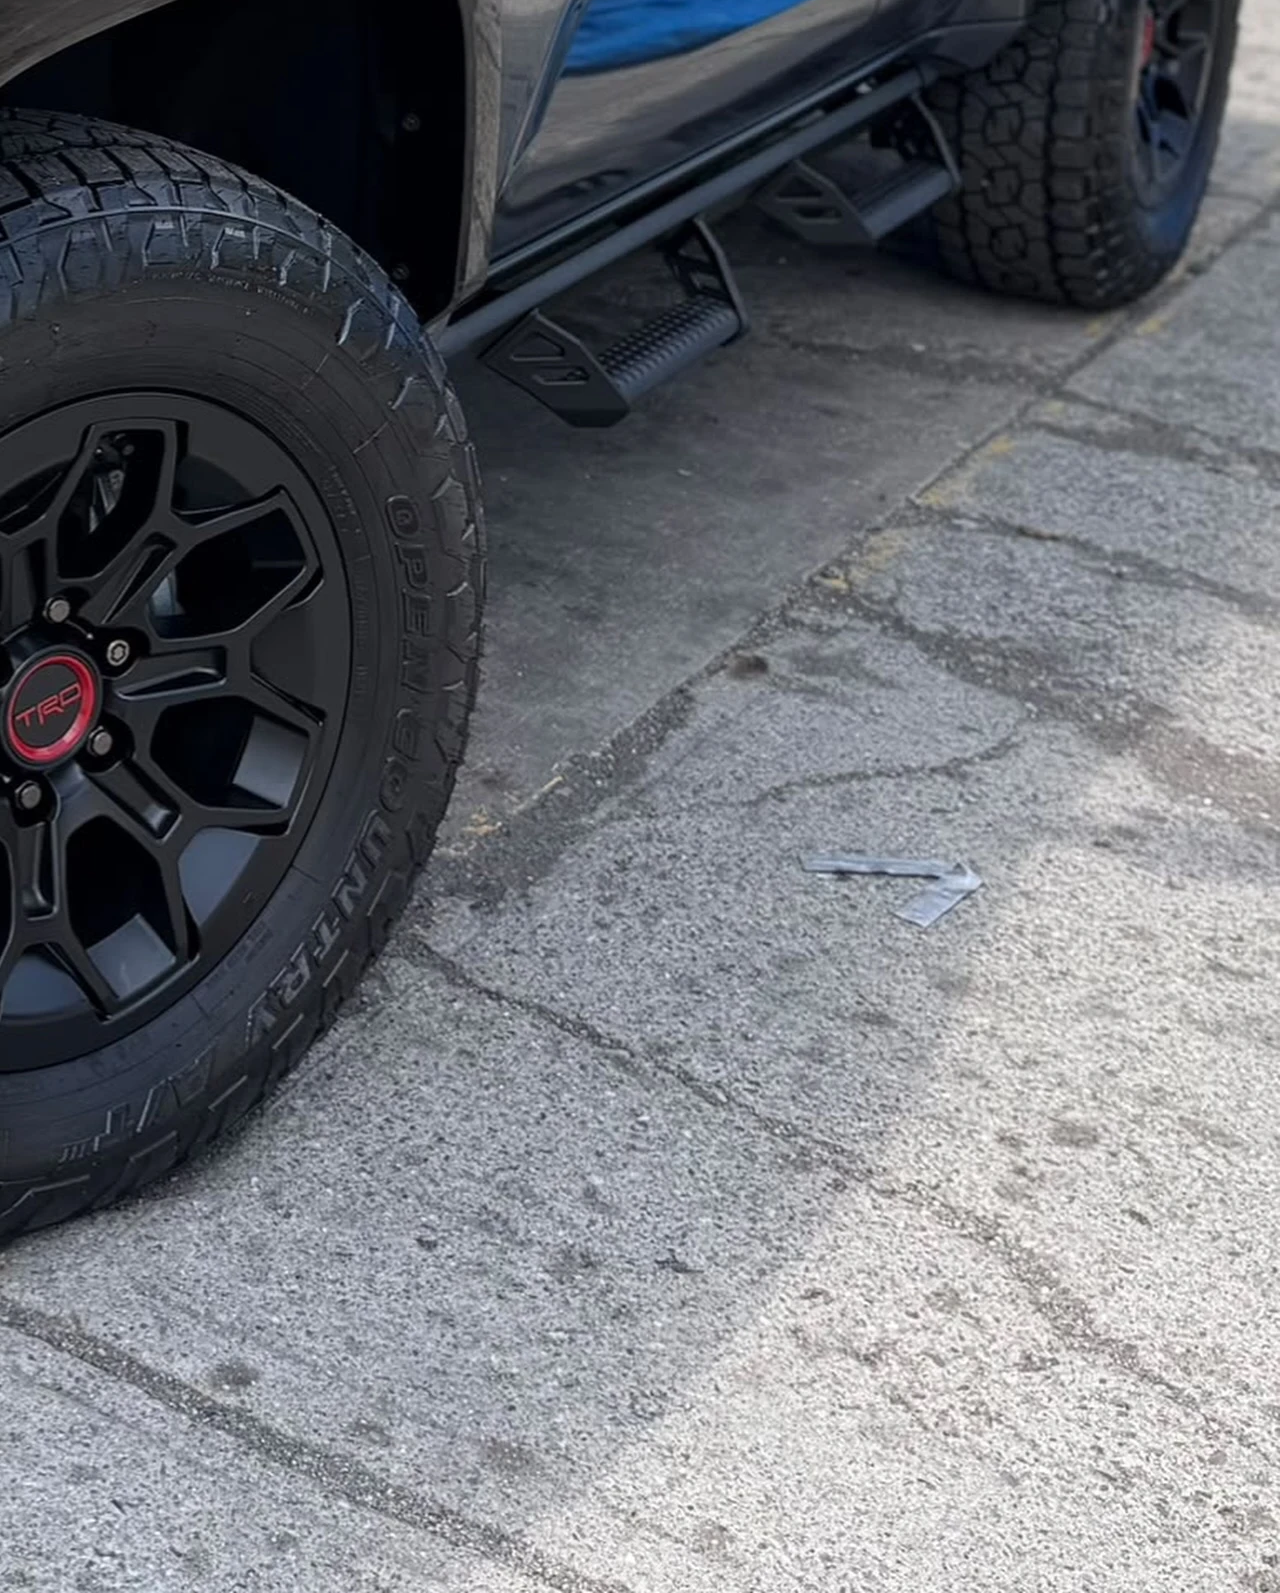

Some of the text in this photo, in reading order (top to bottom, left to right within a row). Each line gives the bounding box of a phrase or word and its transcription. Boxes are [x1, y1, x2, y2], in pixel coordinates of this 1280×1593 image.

[383, 493, 434, 696] OPEN
[15, 682, 82, 727] TRD
[246, 705, 420, 1052] COUNTRY
